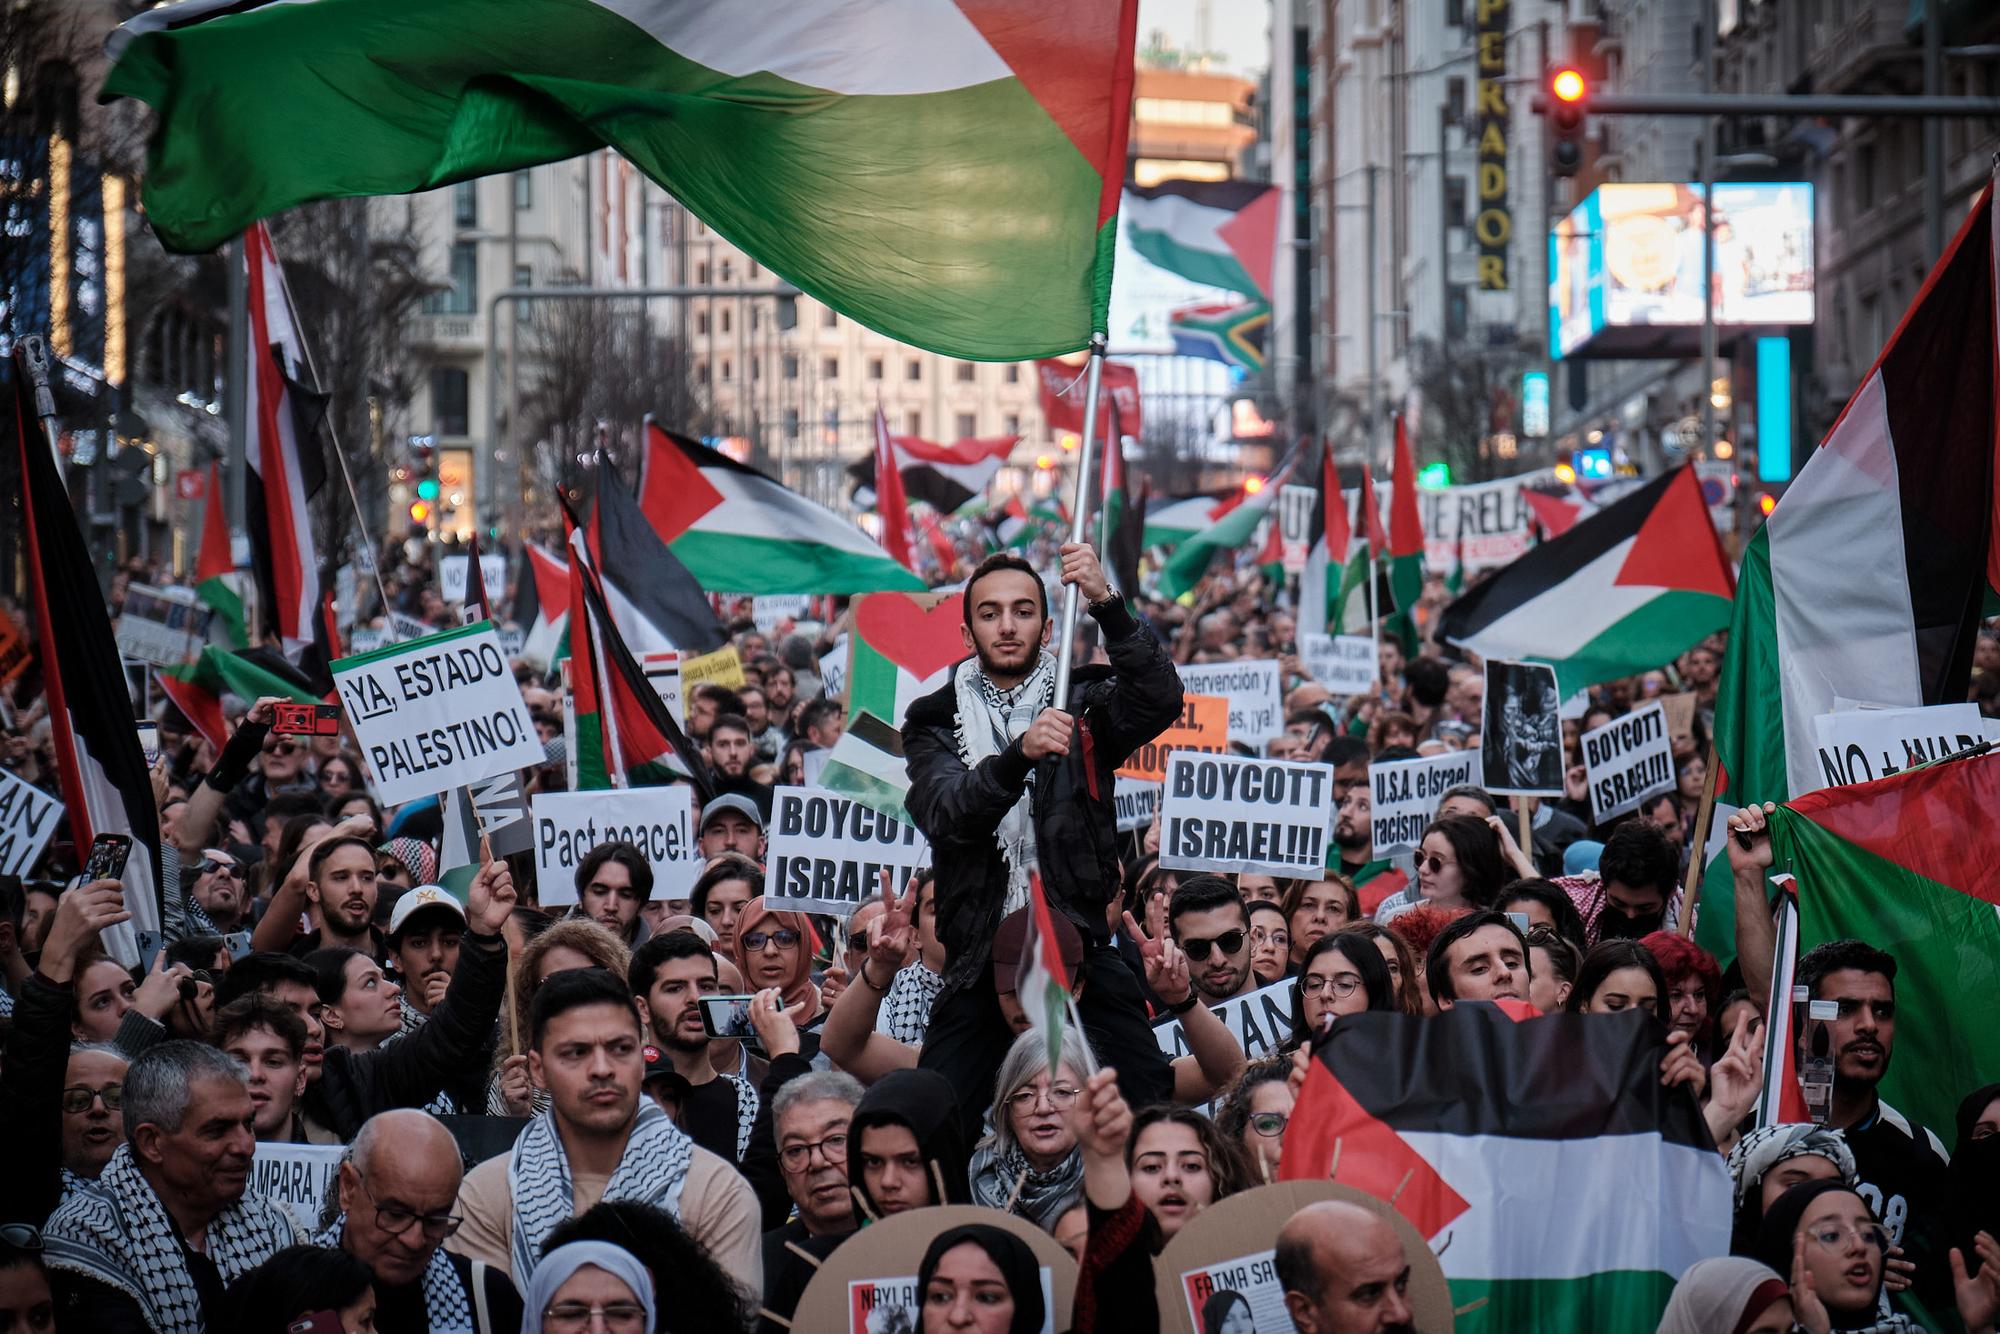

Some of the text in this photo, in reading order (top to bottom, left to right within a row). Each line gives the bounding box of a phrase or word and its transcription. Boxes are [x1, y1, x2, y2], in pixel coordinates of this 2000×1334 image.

[394, 643, 503, 701] ESTADO
[1182, 667, 1271, 695] ntervención y
[370, 708, 527, 782] PALESTINO!
[1587, 709, 1661, 769] BOYCOTT
[1173, 760, 1327, 808] BOYCOTT
[1376, 769, 1412, 805] U.S.A.
[1417, 772, 1426, 799] e
[1594, 751, 1670, 813] ISRAEL!!!
[1819, 743, 1873, 787] NO
[540, 816, 597, 868] Pact
[779, 796, 916, 846] BOYCO
[1169, 817, 1322, 866] ISRAEL!!!
[861, 1285, 915, 1311] NAYLA
[1194, 1260, 1274, 1299] FATMA SA
